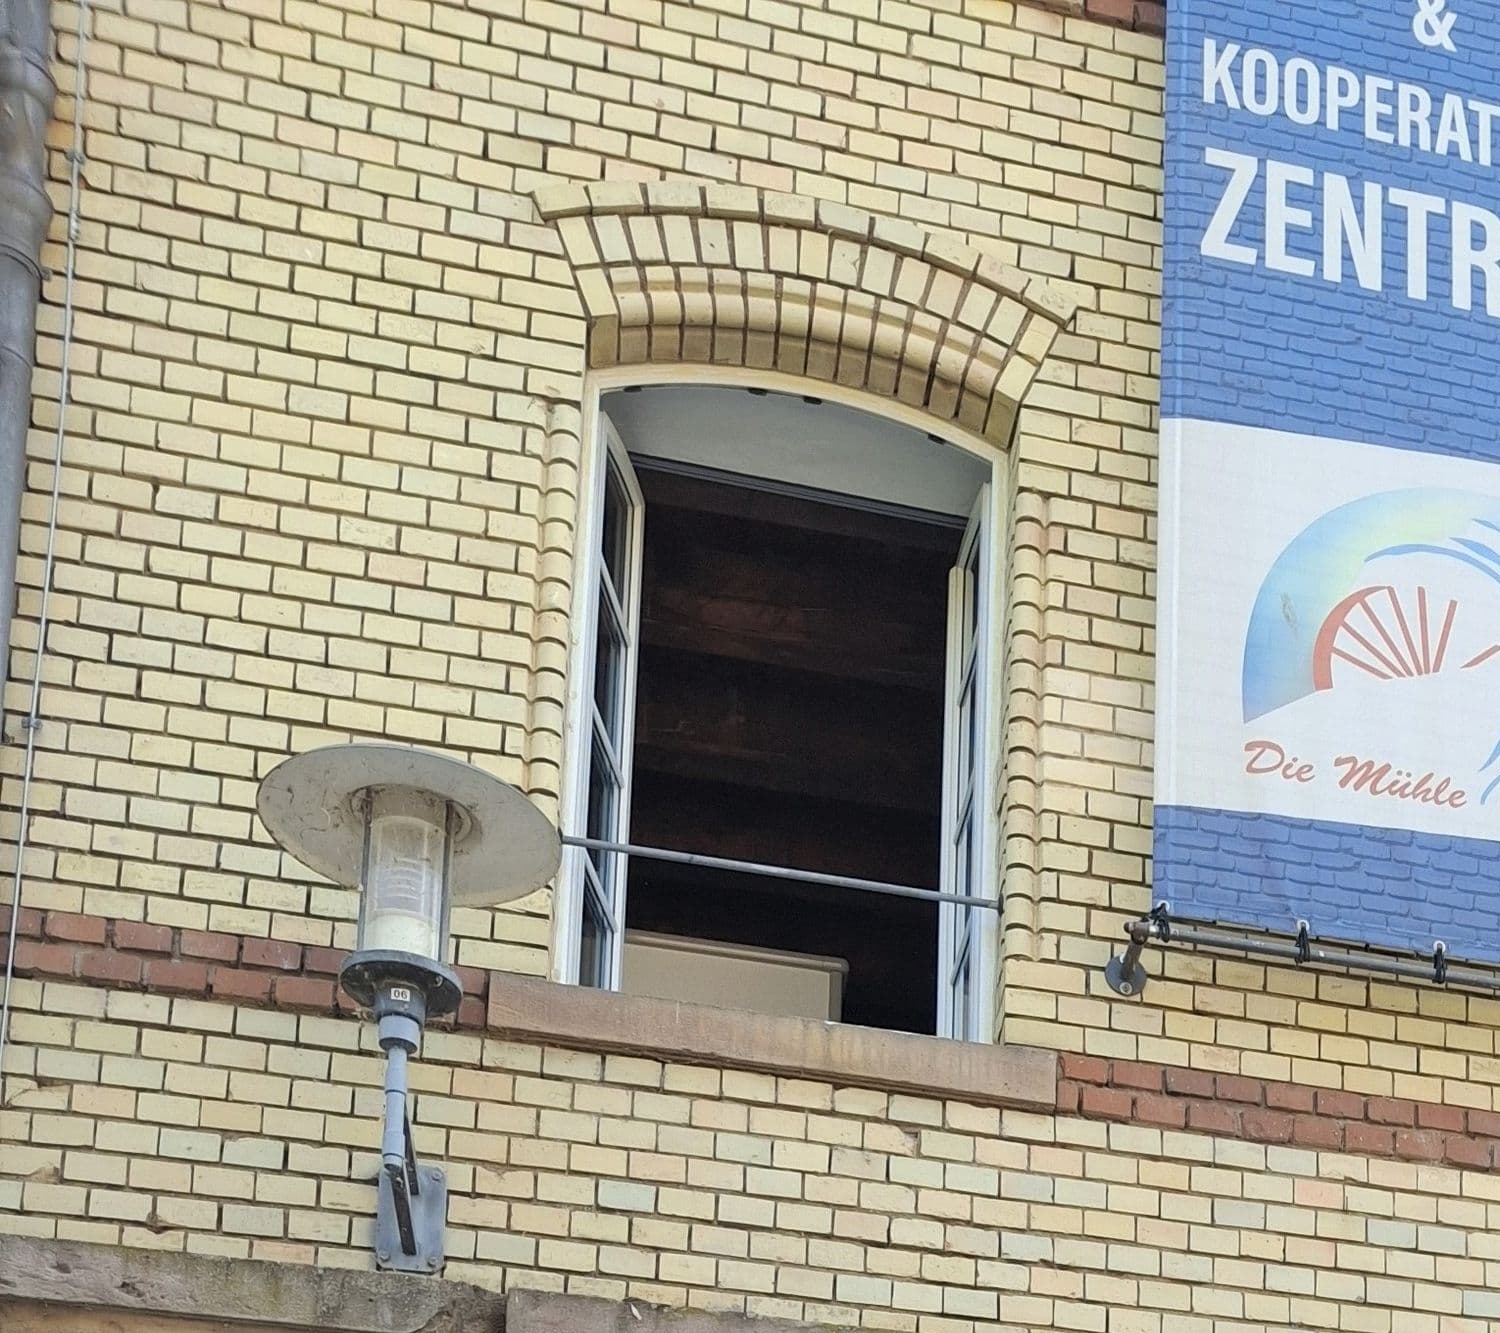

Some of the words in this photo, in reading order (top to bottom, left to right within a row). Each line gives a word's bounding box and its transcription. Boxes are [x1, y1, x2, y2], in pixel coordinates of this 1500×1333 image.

[1412, 0, 1457, 52] &
[1243, 741, 1315, 783] Die
[1334, 754, 1467, 810] Mühle
[393, 989, 408, 1000] 06
